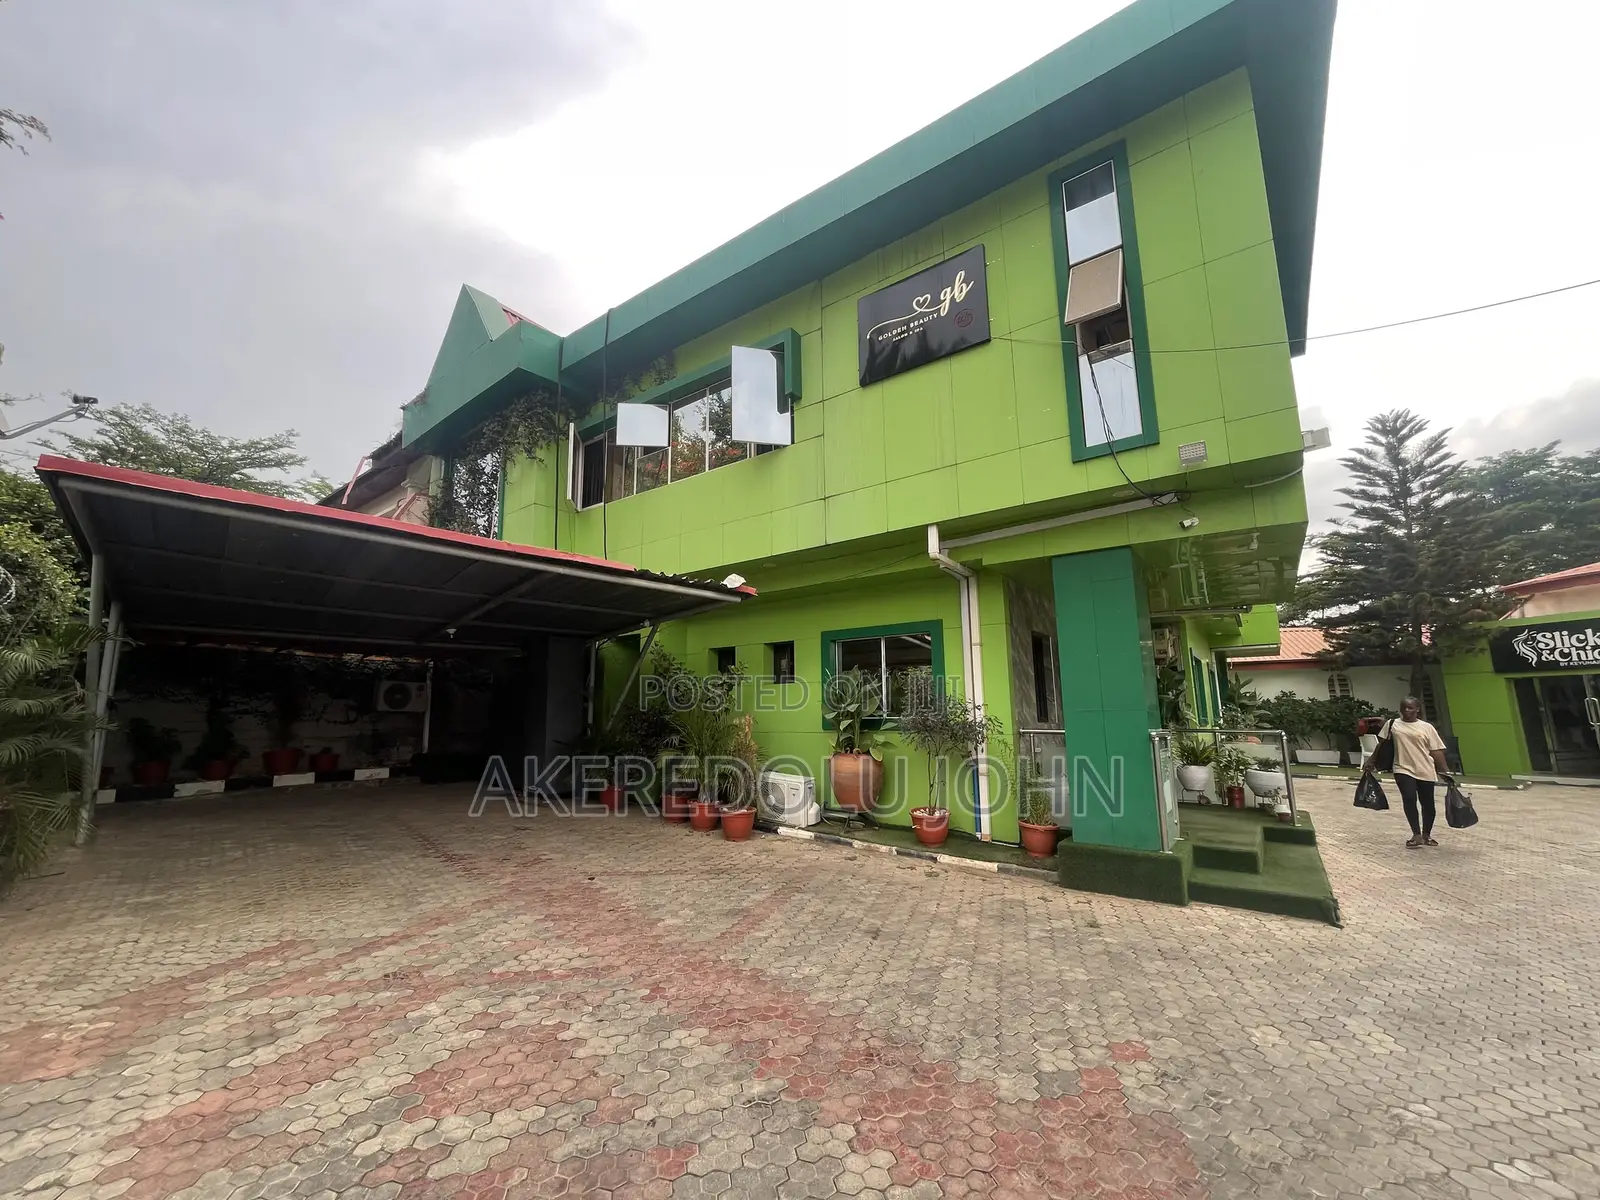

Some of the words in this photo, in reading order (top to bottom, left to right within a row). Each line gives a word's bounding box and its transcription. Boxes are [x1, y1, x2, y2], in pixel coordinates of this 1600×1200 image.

[878, 325, 908, 341] GOLDEN
[909, 312, 938, 328] BEAUTY
[1536, 628, 1600, 649] Slick
